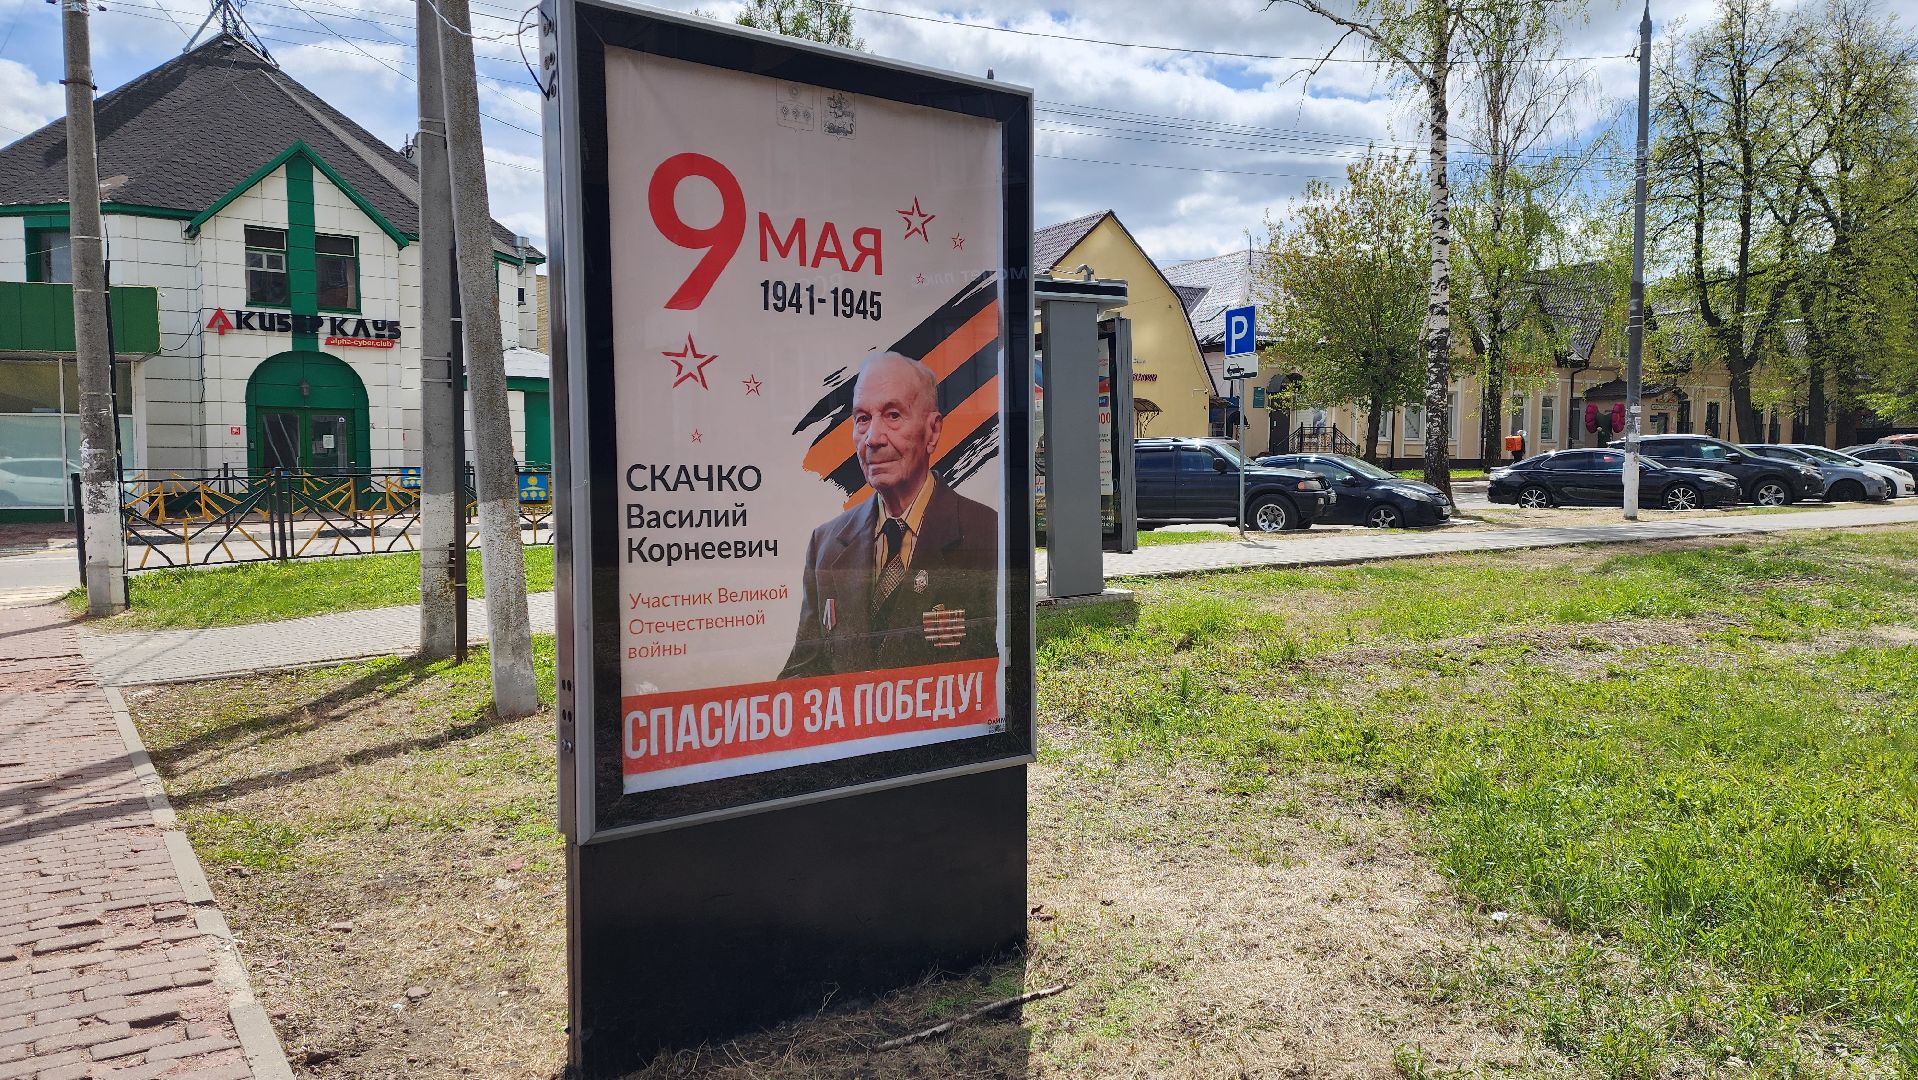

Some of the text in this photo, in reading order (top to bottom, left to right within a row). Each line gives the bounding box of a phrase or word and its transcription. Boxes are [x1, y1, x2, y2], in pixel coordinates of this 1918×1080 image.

[648, 152, 883, 311] 9 МАЯ
[760, 279, 882, 322] 1941-1945
[329, 337, 393, 348] alpha-cyber.club
[626, 463, 762, 492] СКАЧКО
[626, 502, 747, 529] Василий
[627, 536, 778, 567] Корнеевич
[629, 584, 788, 610] Участник Великой
[628, 609, 765, 635] Отечественной
[628, 641, 687, 659] войны
[624, 672, 983, 760] СПАСИБО ЗА ПОБЕДУ!
